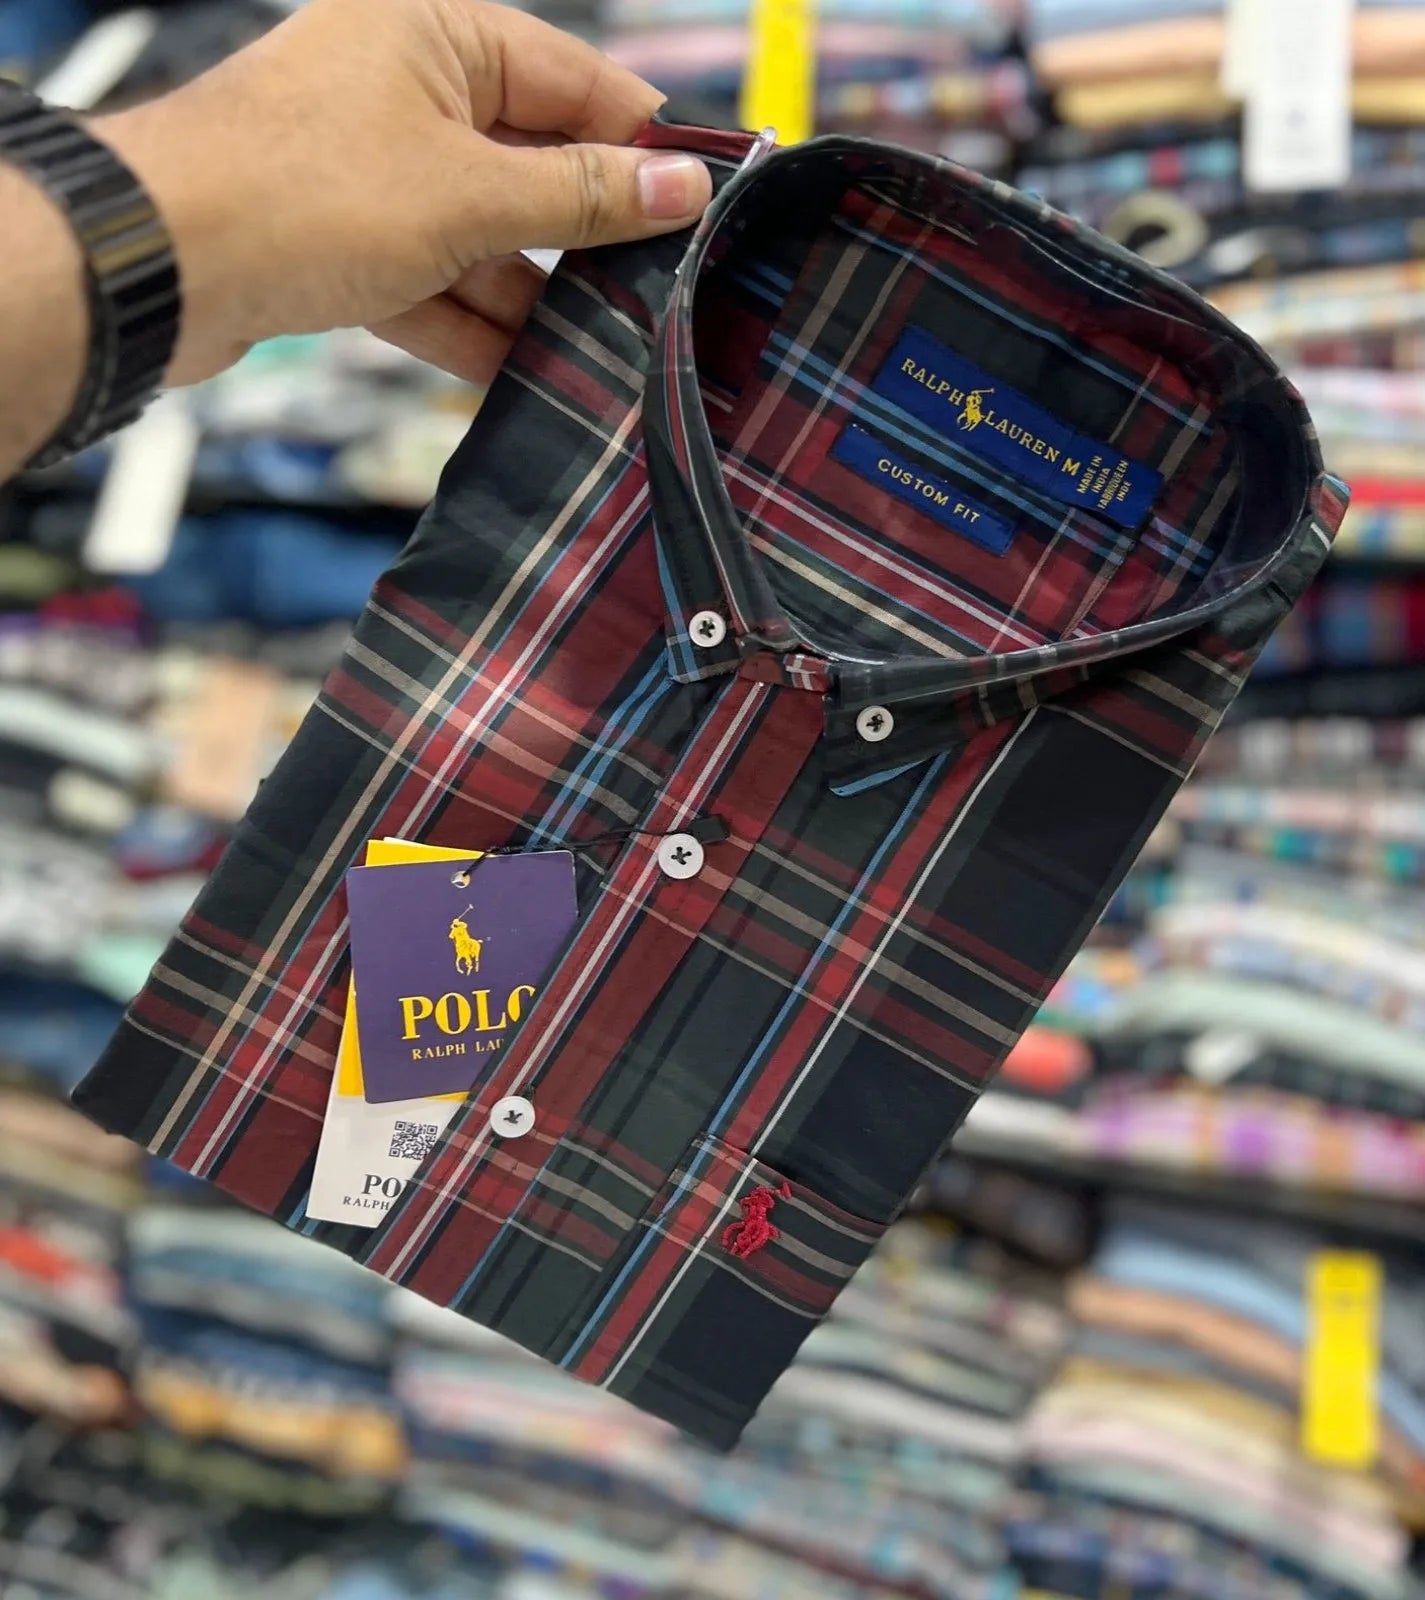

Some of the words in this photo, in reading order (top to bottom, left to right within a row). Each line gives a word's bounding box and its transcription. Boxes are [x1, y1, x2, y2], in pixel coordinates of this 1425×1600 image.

[901, 358, 966, 407] RALPH
[984, 410, 1060, 463] LAUREN
[1061, 457, 1081, 477] M
[1076, 466, 1096, 494] MADE
[1091, 455, 1102, 467] IN
[1091, 467, 1111, 493] INDIA
[877, 459, 949, 506] CUSTOM
[953, 503, 980, 523] FIT
[412, 1043, 466, 1061] RALPH
[361, 1173, 402, 1199] PO
[342, 1195, 391, 1211] RALPH
